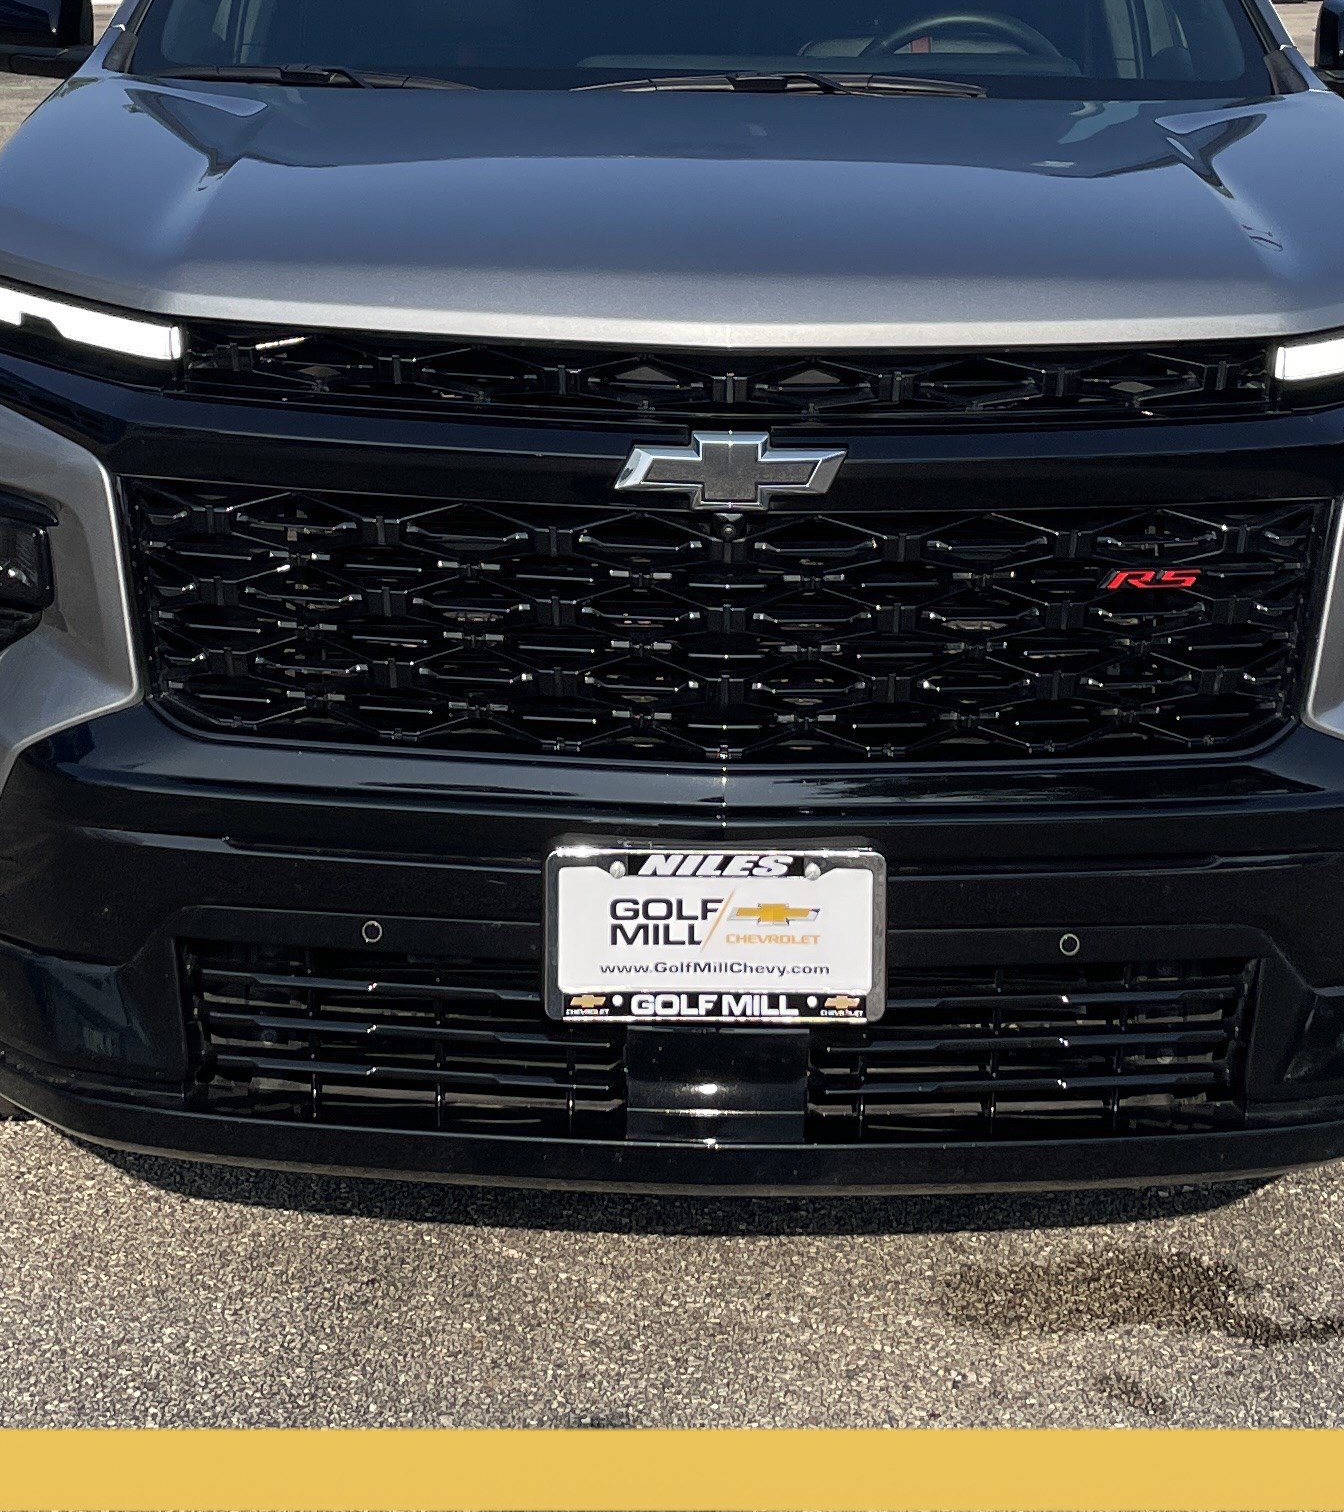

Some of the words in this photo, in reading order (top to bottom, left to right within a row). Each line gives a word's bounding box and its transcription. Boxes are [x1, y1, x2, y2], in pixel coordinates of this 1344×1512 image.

[1106, 569, 1202, 590] RS
[637, 854, 794, 877] NILES
[610, 898, 725, 921] GOLF
[610, 923, 703, 946] MILL
[725, 933, 821, 945] CHEVROLET
[600, 961, 831, 978] www.GolfMillChevy.com
[631, 994, 719, 1016] GOLF
[721, 994, 799, 1016] MILL
